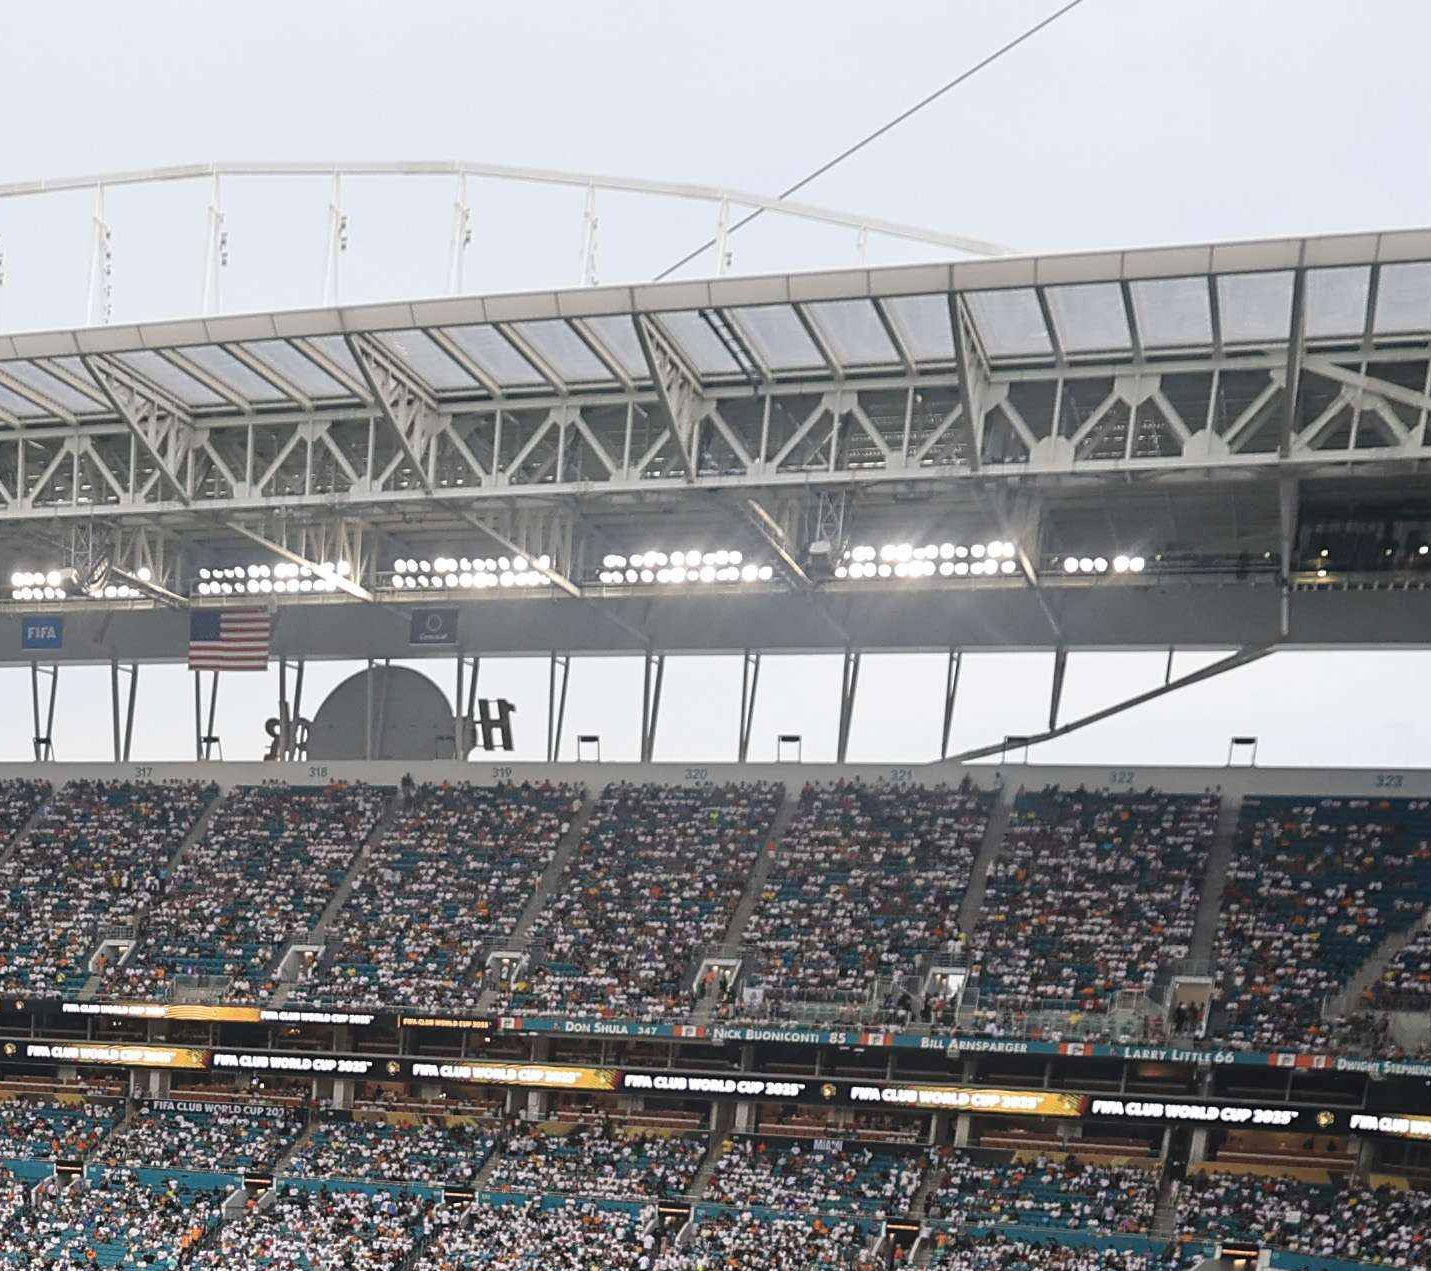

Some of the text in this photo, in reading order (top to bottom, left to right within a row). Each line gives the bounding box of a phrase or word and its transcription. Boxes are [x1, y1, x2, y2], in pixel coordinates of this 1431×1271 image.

[27, 627, 56, 638] FIFA
[309, 767, 328, 777] 318
[493, 767, 512, 777] 319
[684, 768, 707, 779] 320
[637, 1026, 658, 1035] 347
[829, 1032, 846, 1044] 85
[1215, 1051, 1234, 1063] 66
[624, 1074, 652, 1088] FIFA
[653, 1076, 687, 1091] CLUB
[688, 1078, 736, 1093] WORLD
[737, 1081, 765, 1095] CUP
